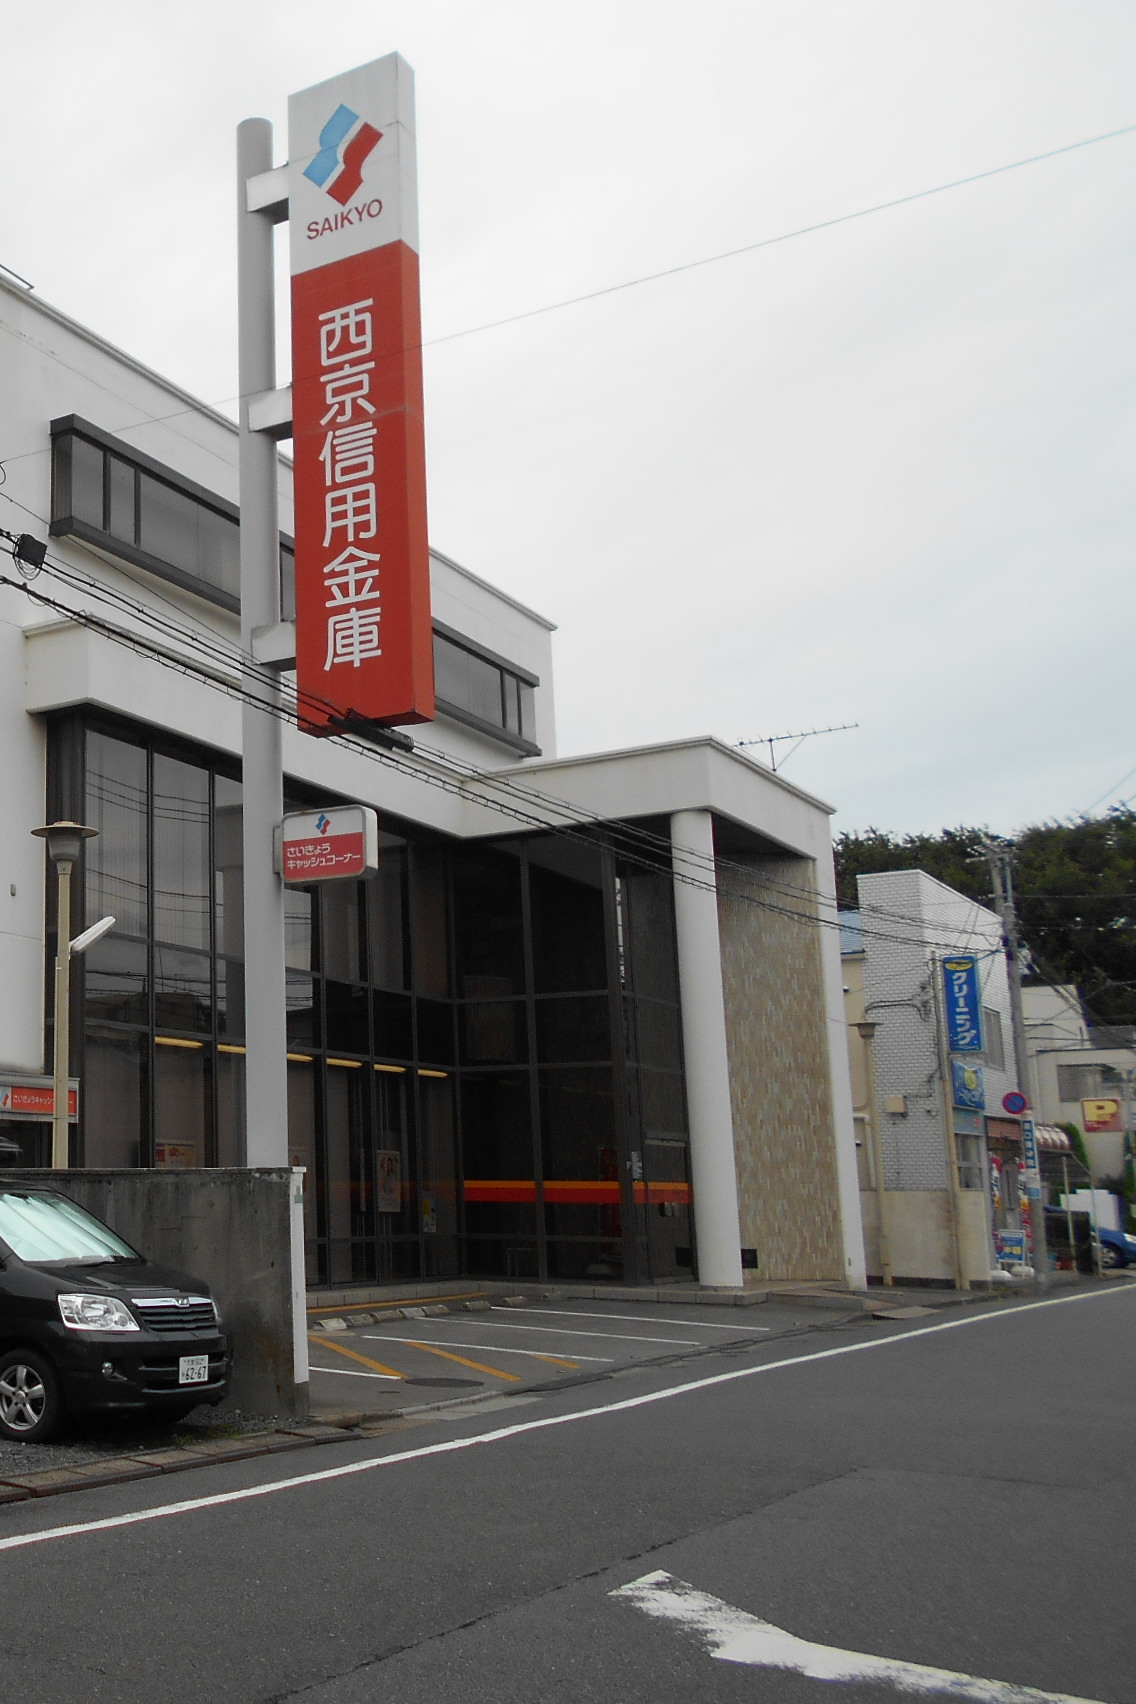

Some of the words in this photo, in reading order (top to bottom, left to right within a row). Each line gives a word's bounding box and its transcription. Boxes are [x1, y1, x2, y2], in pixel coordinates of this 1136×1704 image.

[306, 199, 383, 240] SAIKYO
[318, 297, 383, 672] 西京信用金庫
[287, 843, 331, 858] さいきょう
[287, 853, 361, 870] キャッシュコーナー
[952, 971, 977, 1045] クリーニング
